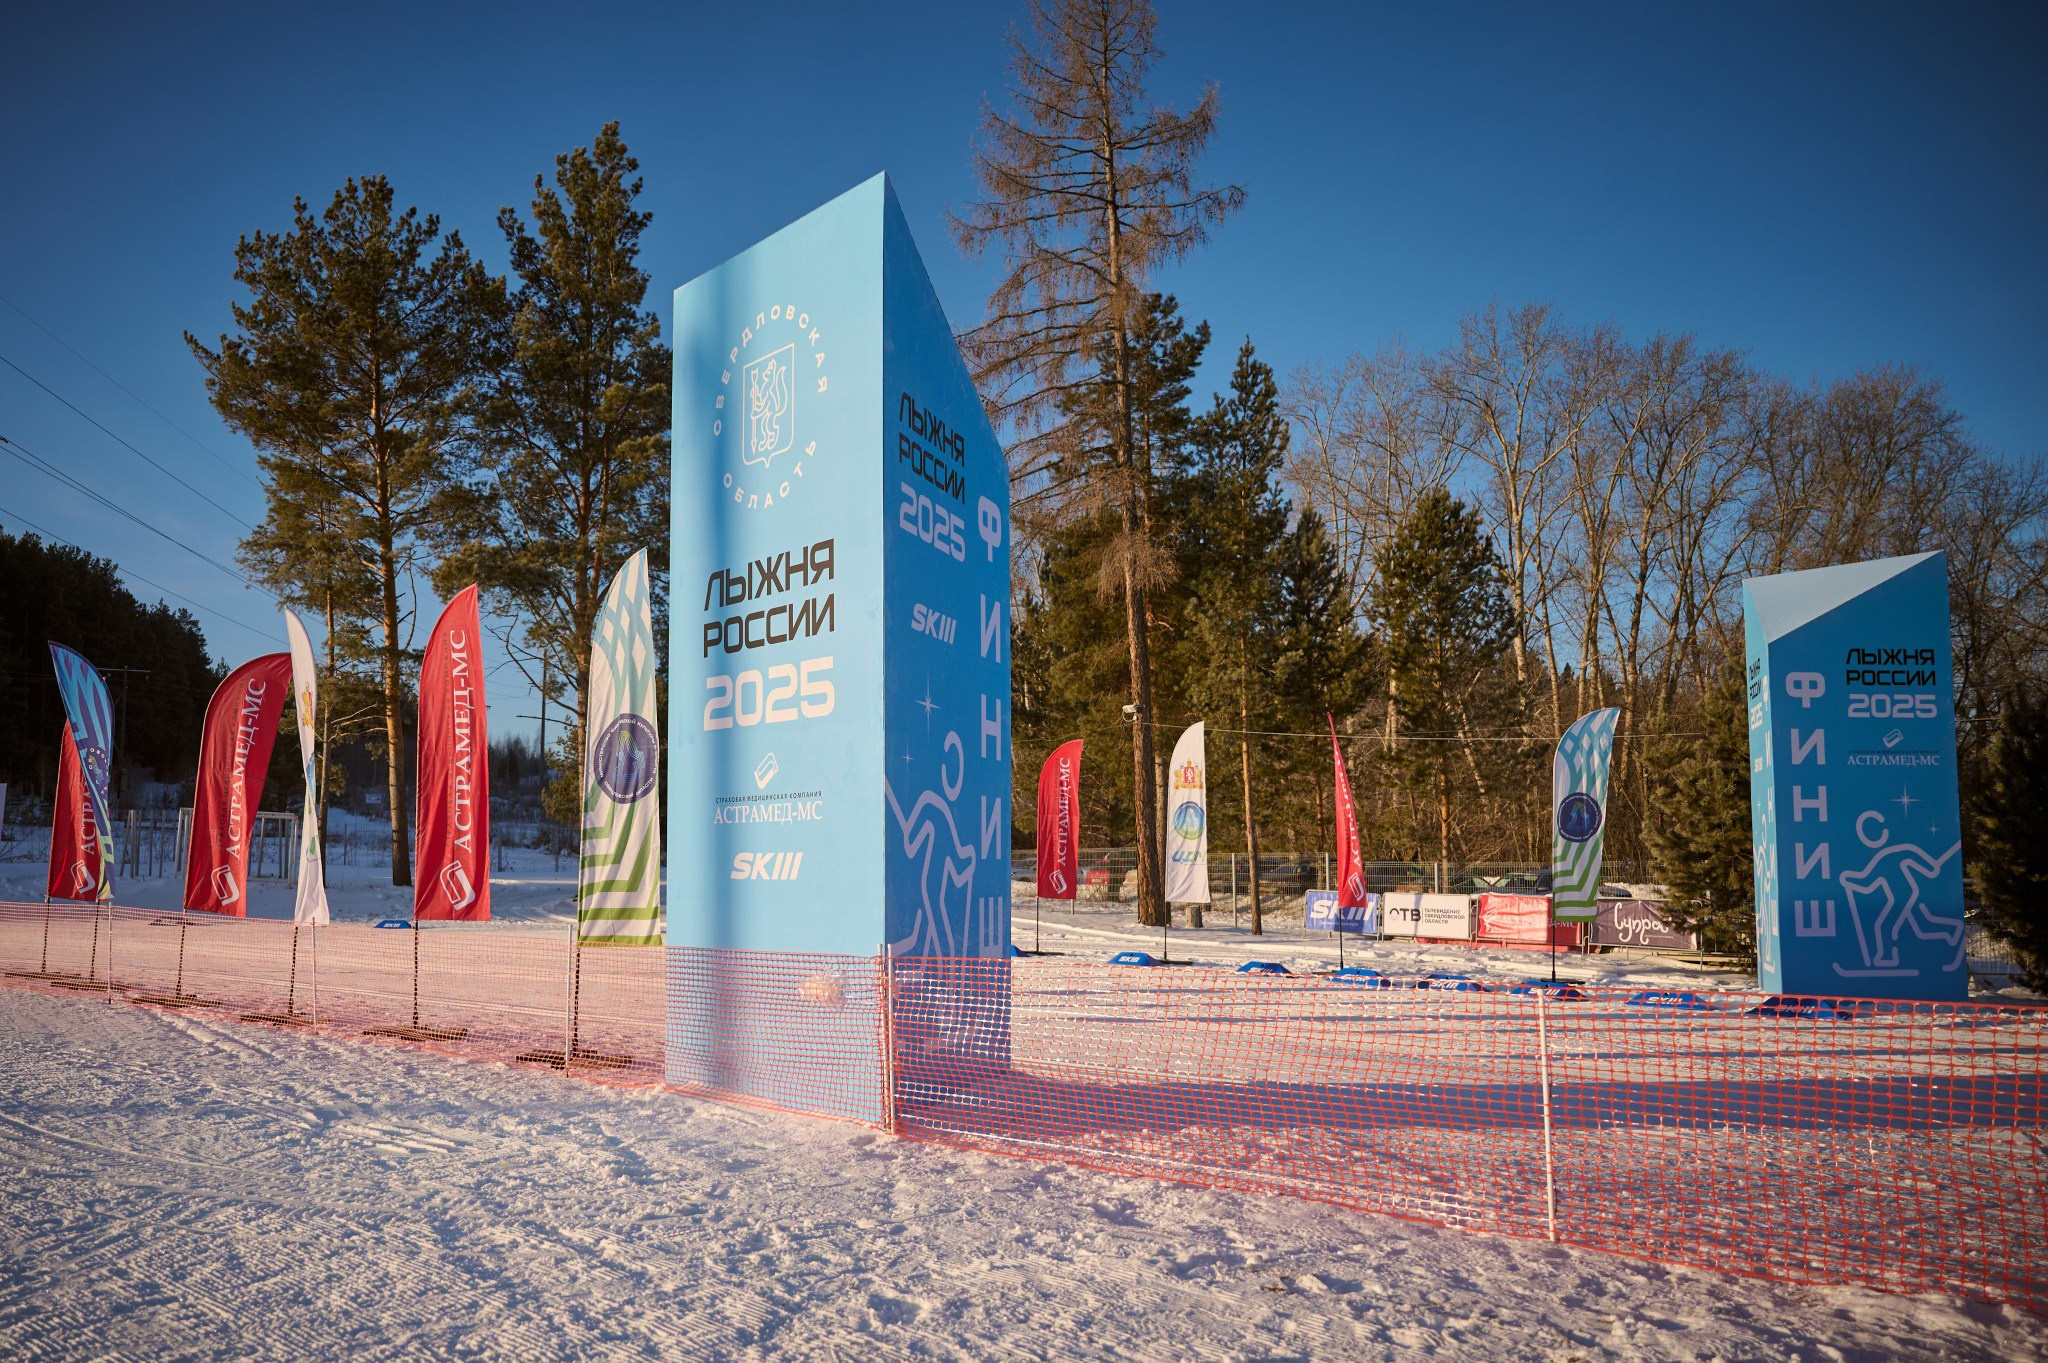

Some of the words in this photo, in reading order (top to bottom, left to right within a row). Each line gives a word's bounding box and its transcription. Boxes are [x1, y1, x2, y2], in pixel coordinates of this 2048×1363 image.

[714, 304, 828, 436] СВЕРДЛОВСКАЯ
[900, 391, 965, 467] ЛЫЖНЯ
[723, 440, 816, 509] ОБЛАСТЬ
[899, 432, 965, 504] РОССИИ
[899, 481, 966, 562] 2025
[703, 538, 834, 612] ЛЫЖНЯ
[703, 593, 834, 658] РОССИИ
[1846, 648, 1936, 666] ЛЫЖНЯ
[703, 655, 836, 731] 2025
[1846, 669, 1937, 687] РОССИИ
[1847, 694, 1938, 719] 2025
[450, 630, 475, 854] АСТРАМЕД-МС
[977, 495, 1004, 960] ФИНИШ
[1847, 754, 1941, 768] АСТРАМЕД-МС
[225, 678, 266, 861] АСТРАМЕД-МС
[746, 793, 788, 802] МЕДИЦИНСКАЯ
[789, 790, 822, 799] КОМПАНИЯ
[1784, 671, 1837, 938] ФИНИШ
[80, 779, 97, 857] АСТРА
[713, 800, 824, 825] АСТРАМЕД-МС
[1057, 757, 1072, 866] АСТРАМЕД-МС
